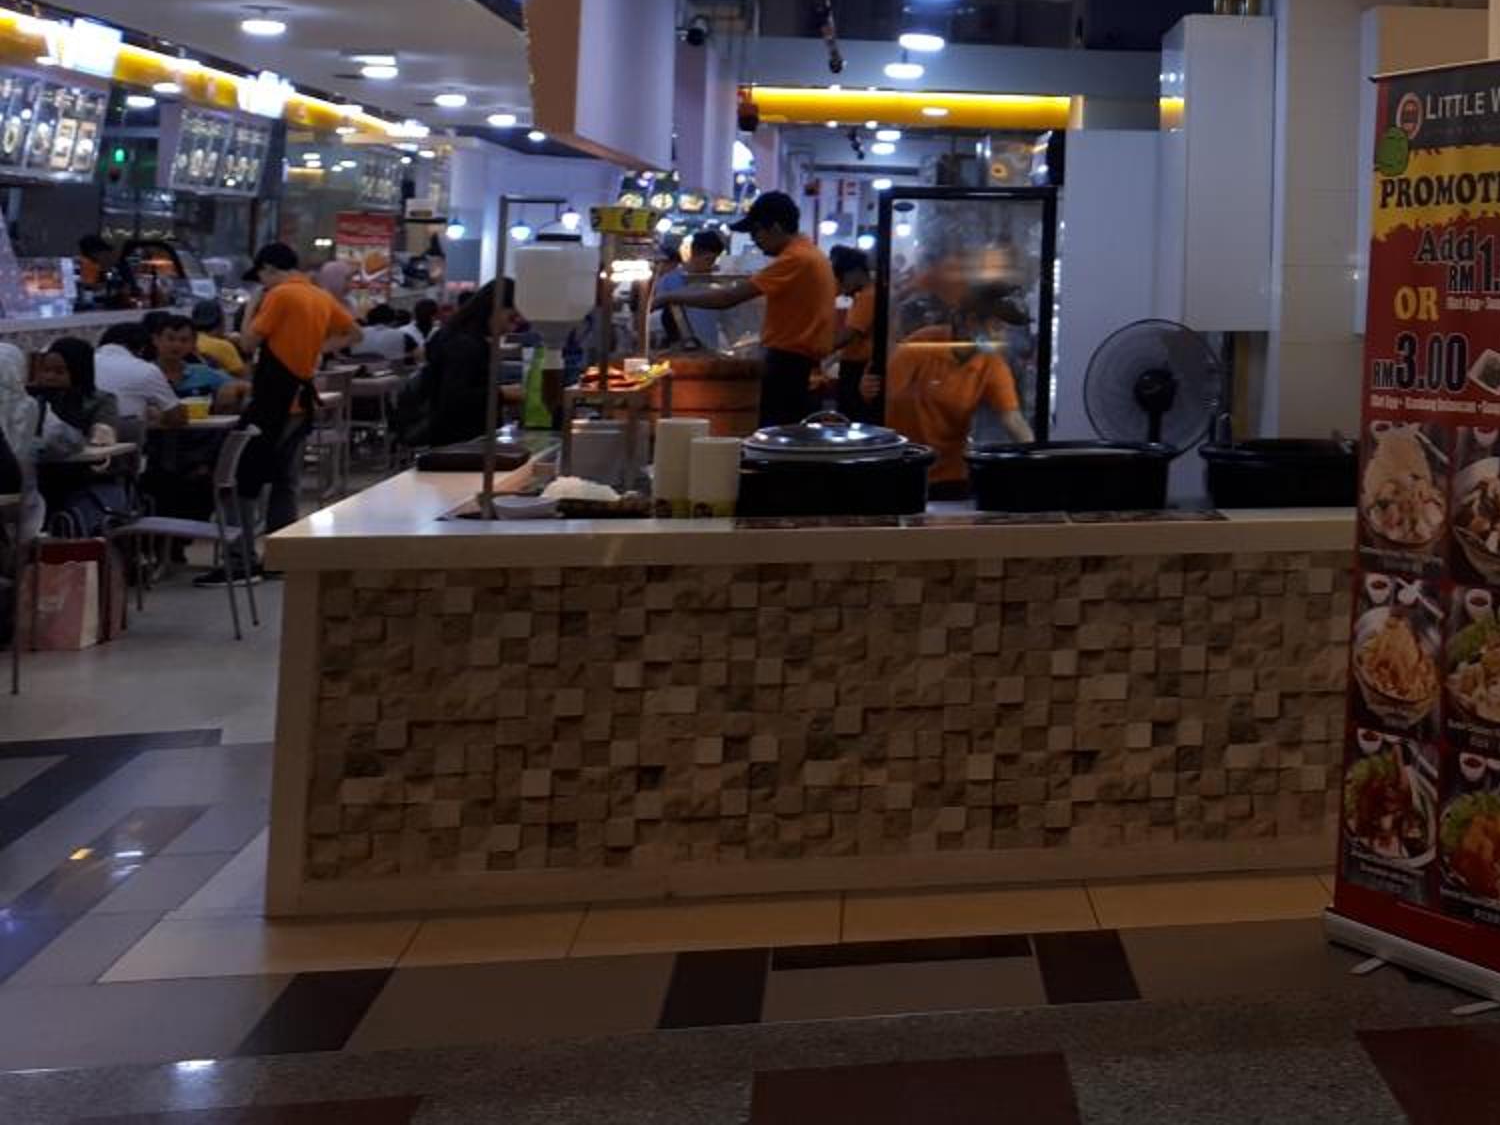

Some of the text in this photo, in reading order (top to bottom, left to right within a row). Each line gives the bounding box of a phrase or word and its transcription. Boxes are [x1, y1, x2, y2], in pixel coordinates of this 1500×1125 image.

[1425, 90, 1486, 120] LITTLE
[1416, 226, 1476, 263] Add
[1393, 285, 1441, 322] OR
